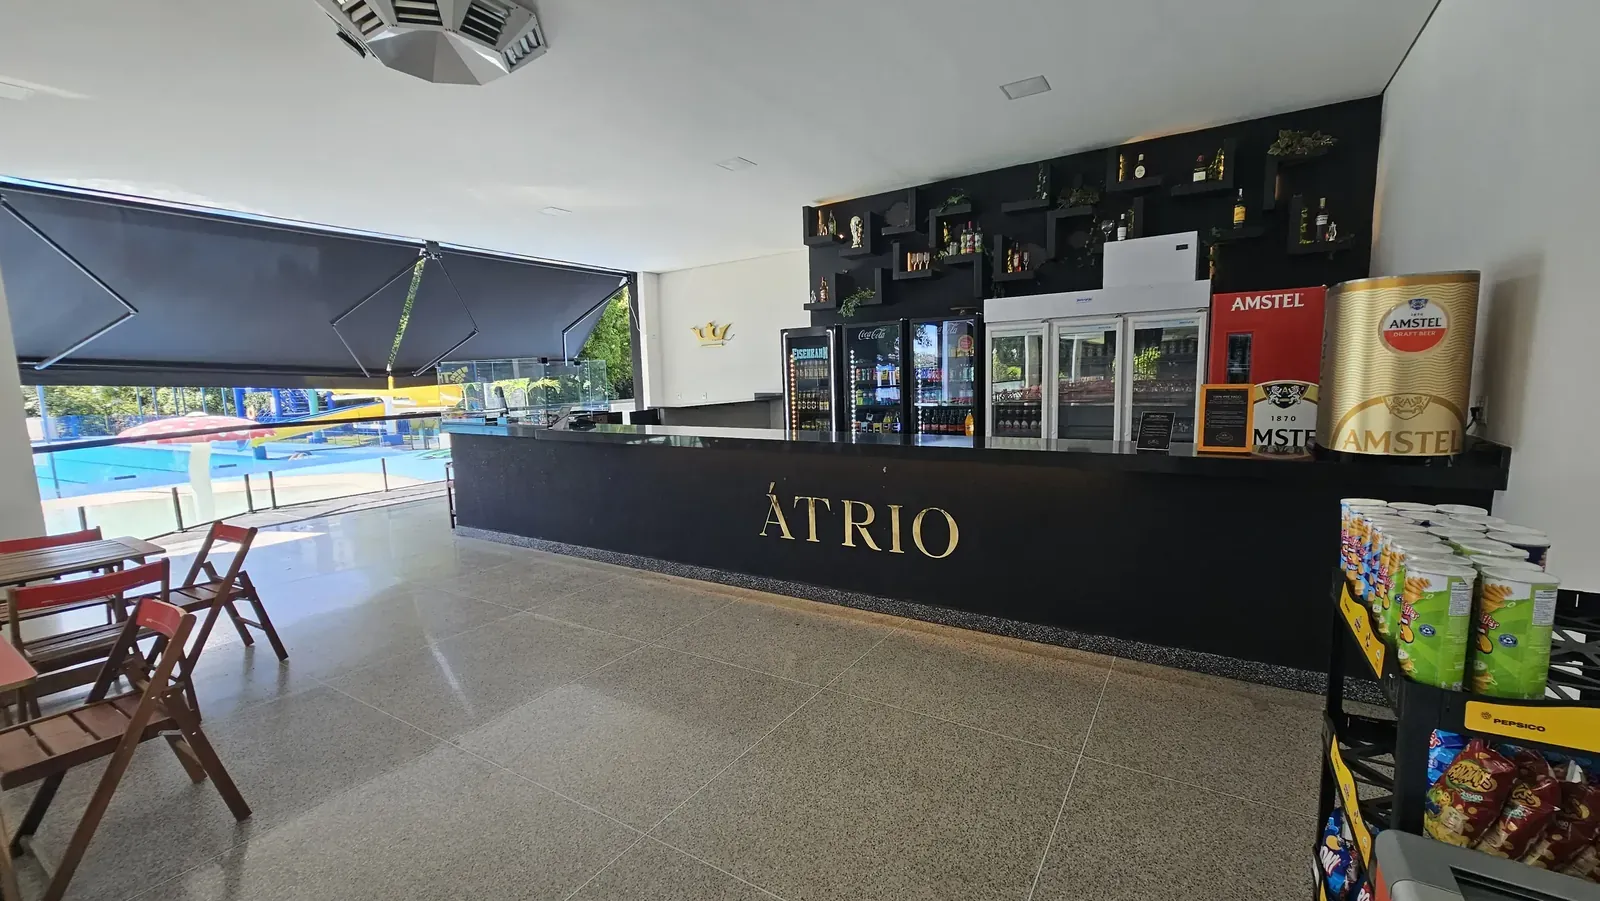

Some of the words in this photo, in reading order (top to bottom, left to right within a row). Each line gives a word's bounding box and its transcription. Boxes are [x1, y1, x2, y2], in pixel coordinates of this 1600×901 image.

[1230, 293, 1304, 312] AMSTEL
[1389, 317, 1442, 329] AMSTEL
[1342, 429, 1460, 454] AMSTEL
[759, 481, 959, 558] ÁTRIO
[1493, 718, 1546, 732] PEPSICO
